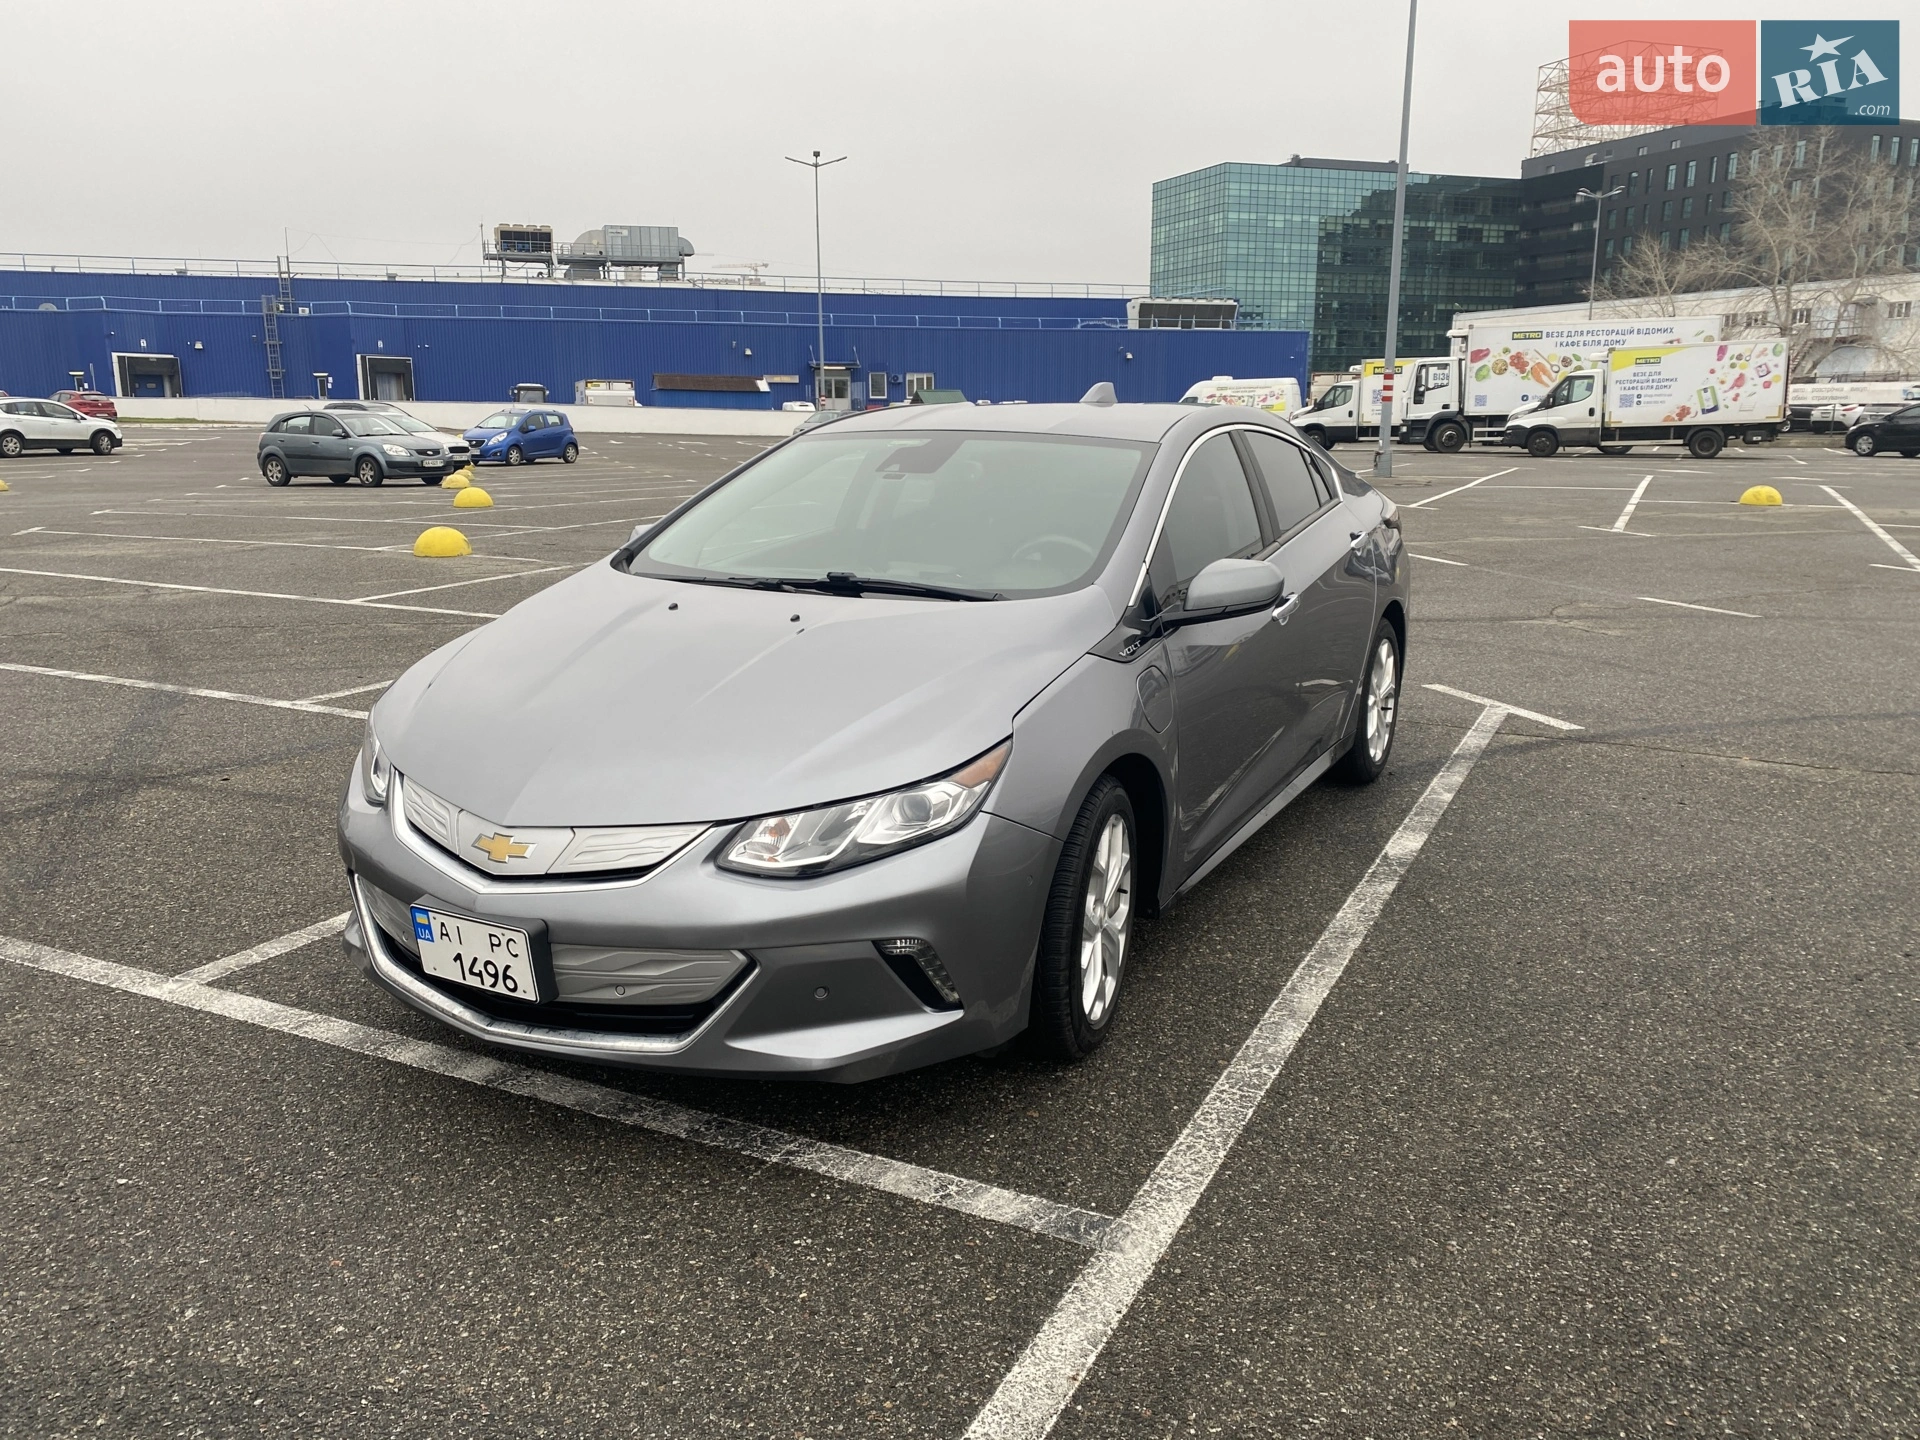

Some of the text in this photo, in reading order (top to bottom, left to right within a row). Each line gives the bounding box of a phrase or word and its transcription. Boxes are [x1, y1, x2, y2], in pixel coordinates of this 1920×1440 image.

[1512, 331, 1543, 340] METRO
[1545, 327, 1674, 339] ВЕЗЕ ДЛЯ РЕСТОРАЦІЙ ВІДОМИХ
[1603, 339, 1626, 347] ДОМУ
[1374, 366, 1402, 374] MEO
[1119, 640, 1140, 656] VOLT
[418, 928, 432, 940] UA
[440, 921, 519, 958] AI PC
[453, 952, 518, 993] 1496
